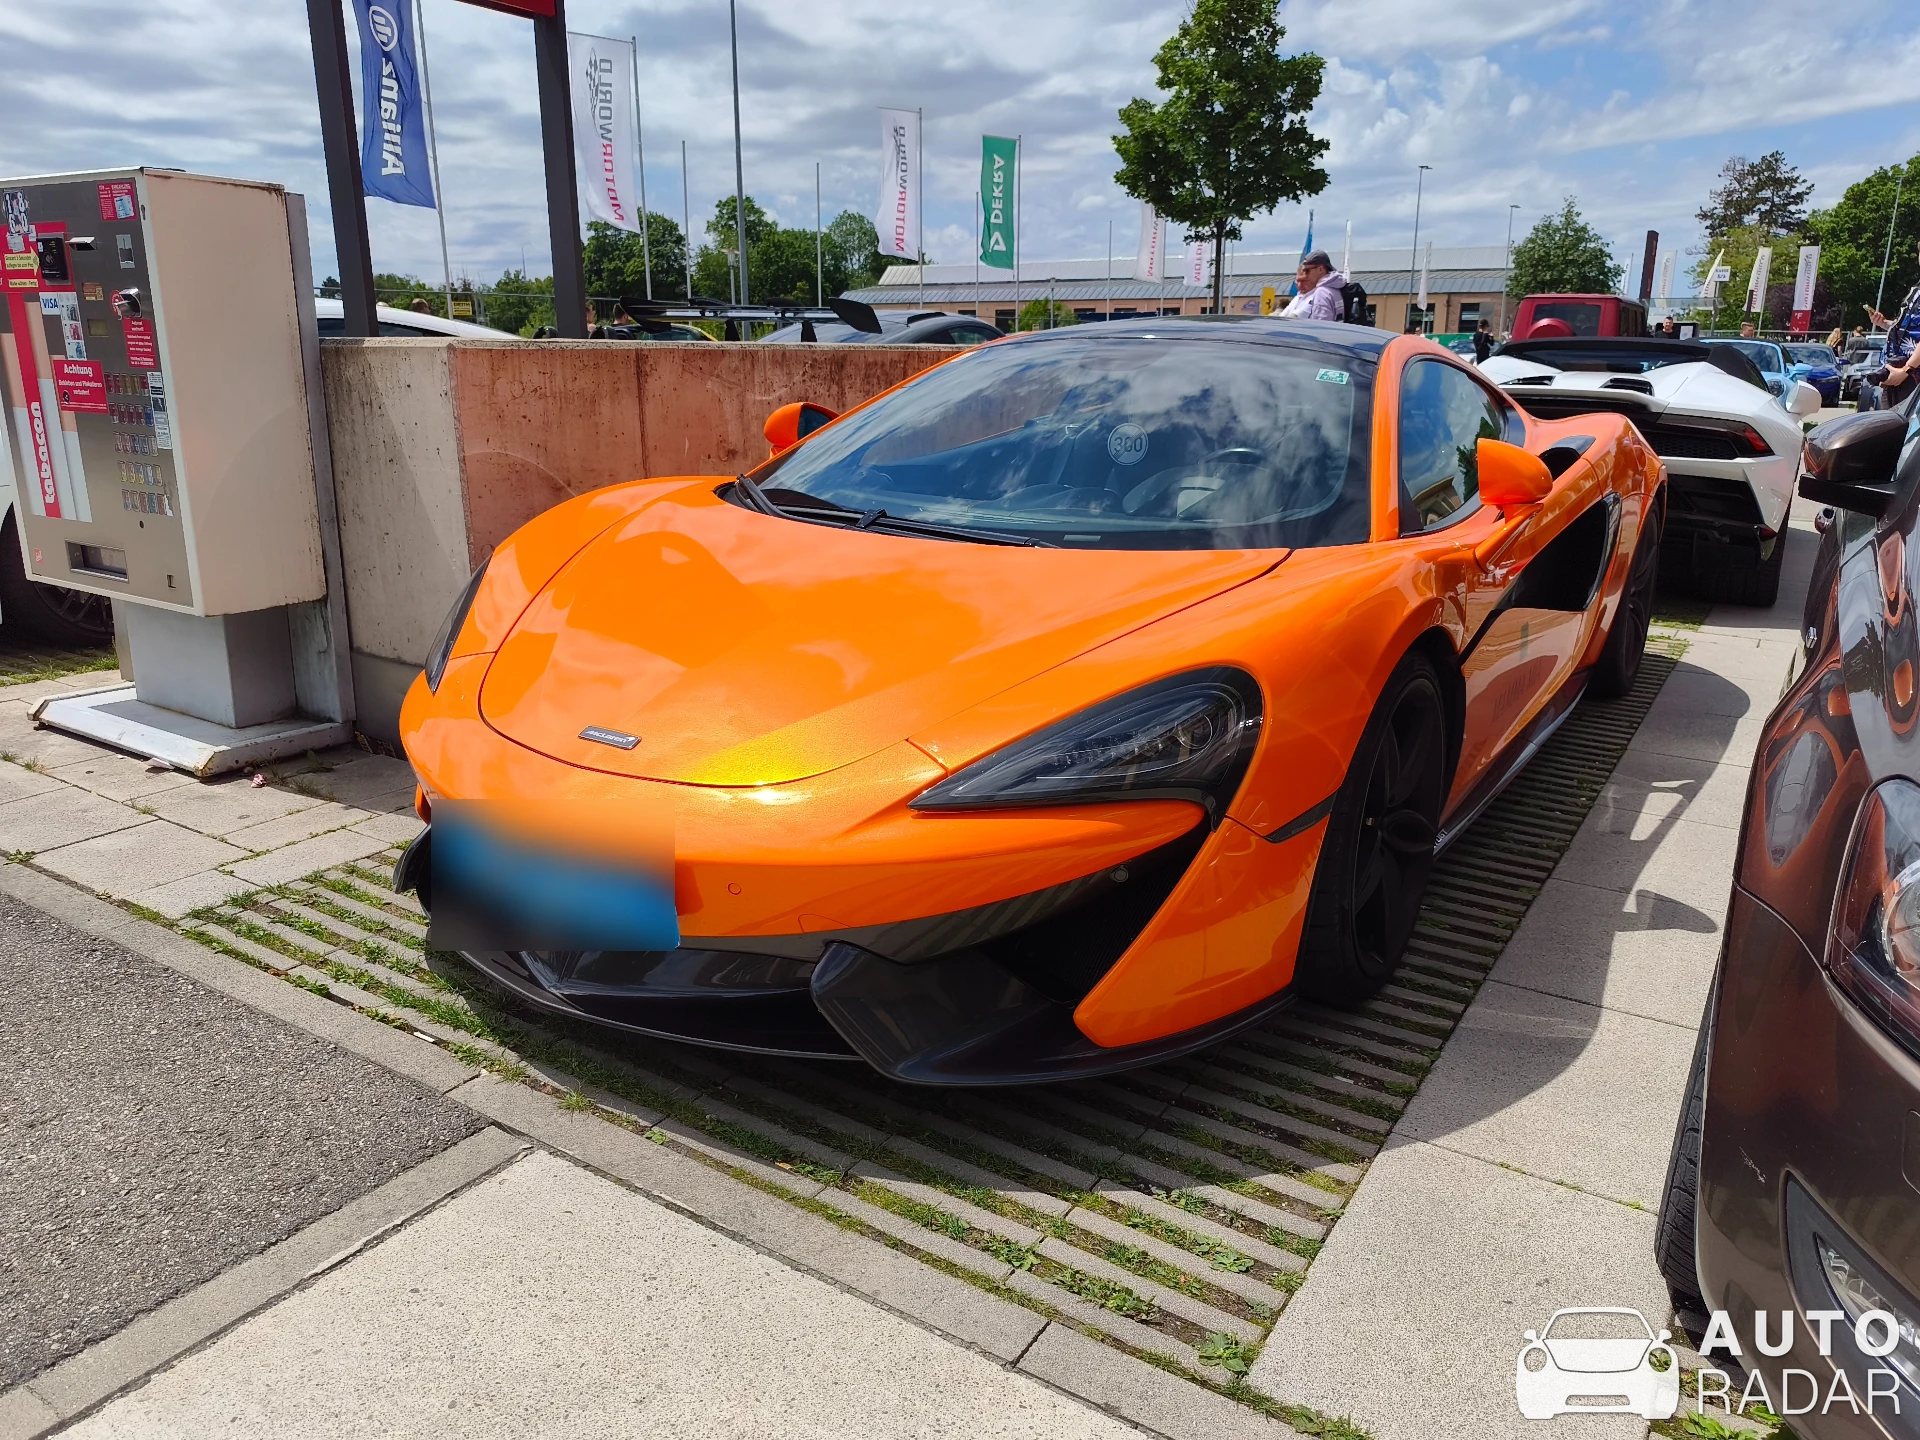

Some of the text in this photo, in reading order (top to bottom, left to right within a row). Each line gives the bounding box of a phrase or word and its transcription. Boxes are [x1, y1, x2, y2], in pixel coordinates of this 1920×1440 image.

[42, 298, 59, 309] VISA
[64, 363, 93, 377] Achtung
[585, 730, 627, 743] McLaren
